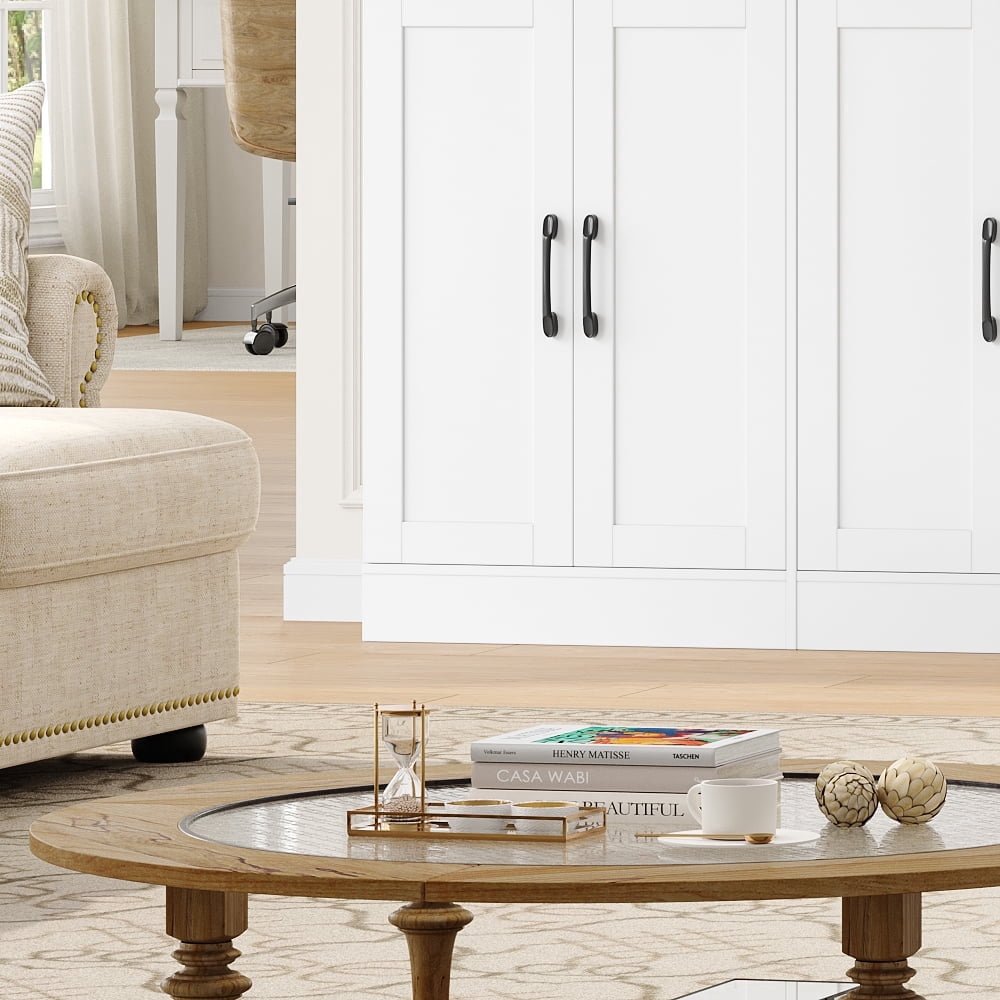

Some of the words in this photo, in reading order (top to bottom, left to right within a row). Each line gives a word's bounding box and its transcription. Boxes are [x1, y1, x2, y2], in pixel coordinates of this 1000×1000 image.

[552, 750, 586, 759] HENRY
[588, 750, 630, 760] MATISSE
[496, 769, 543, 784] CASA
[547, 770, 589, 784] WABI
